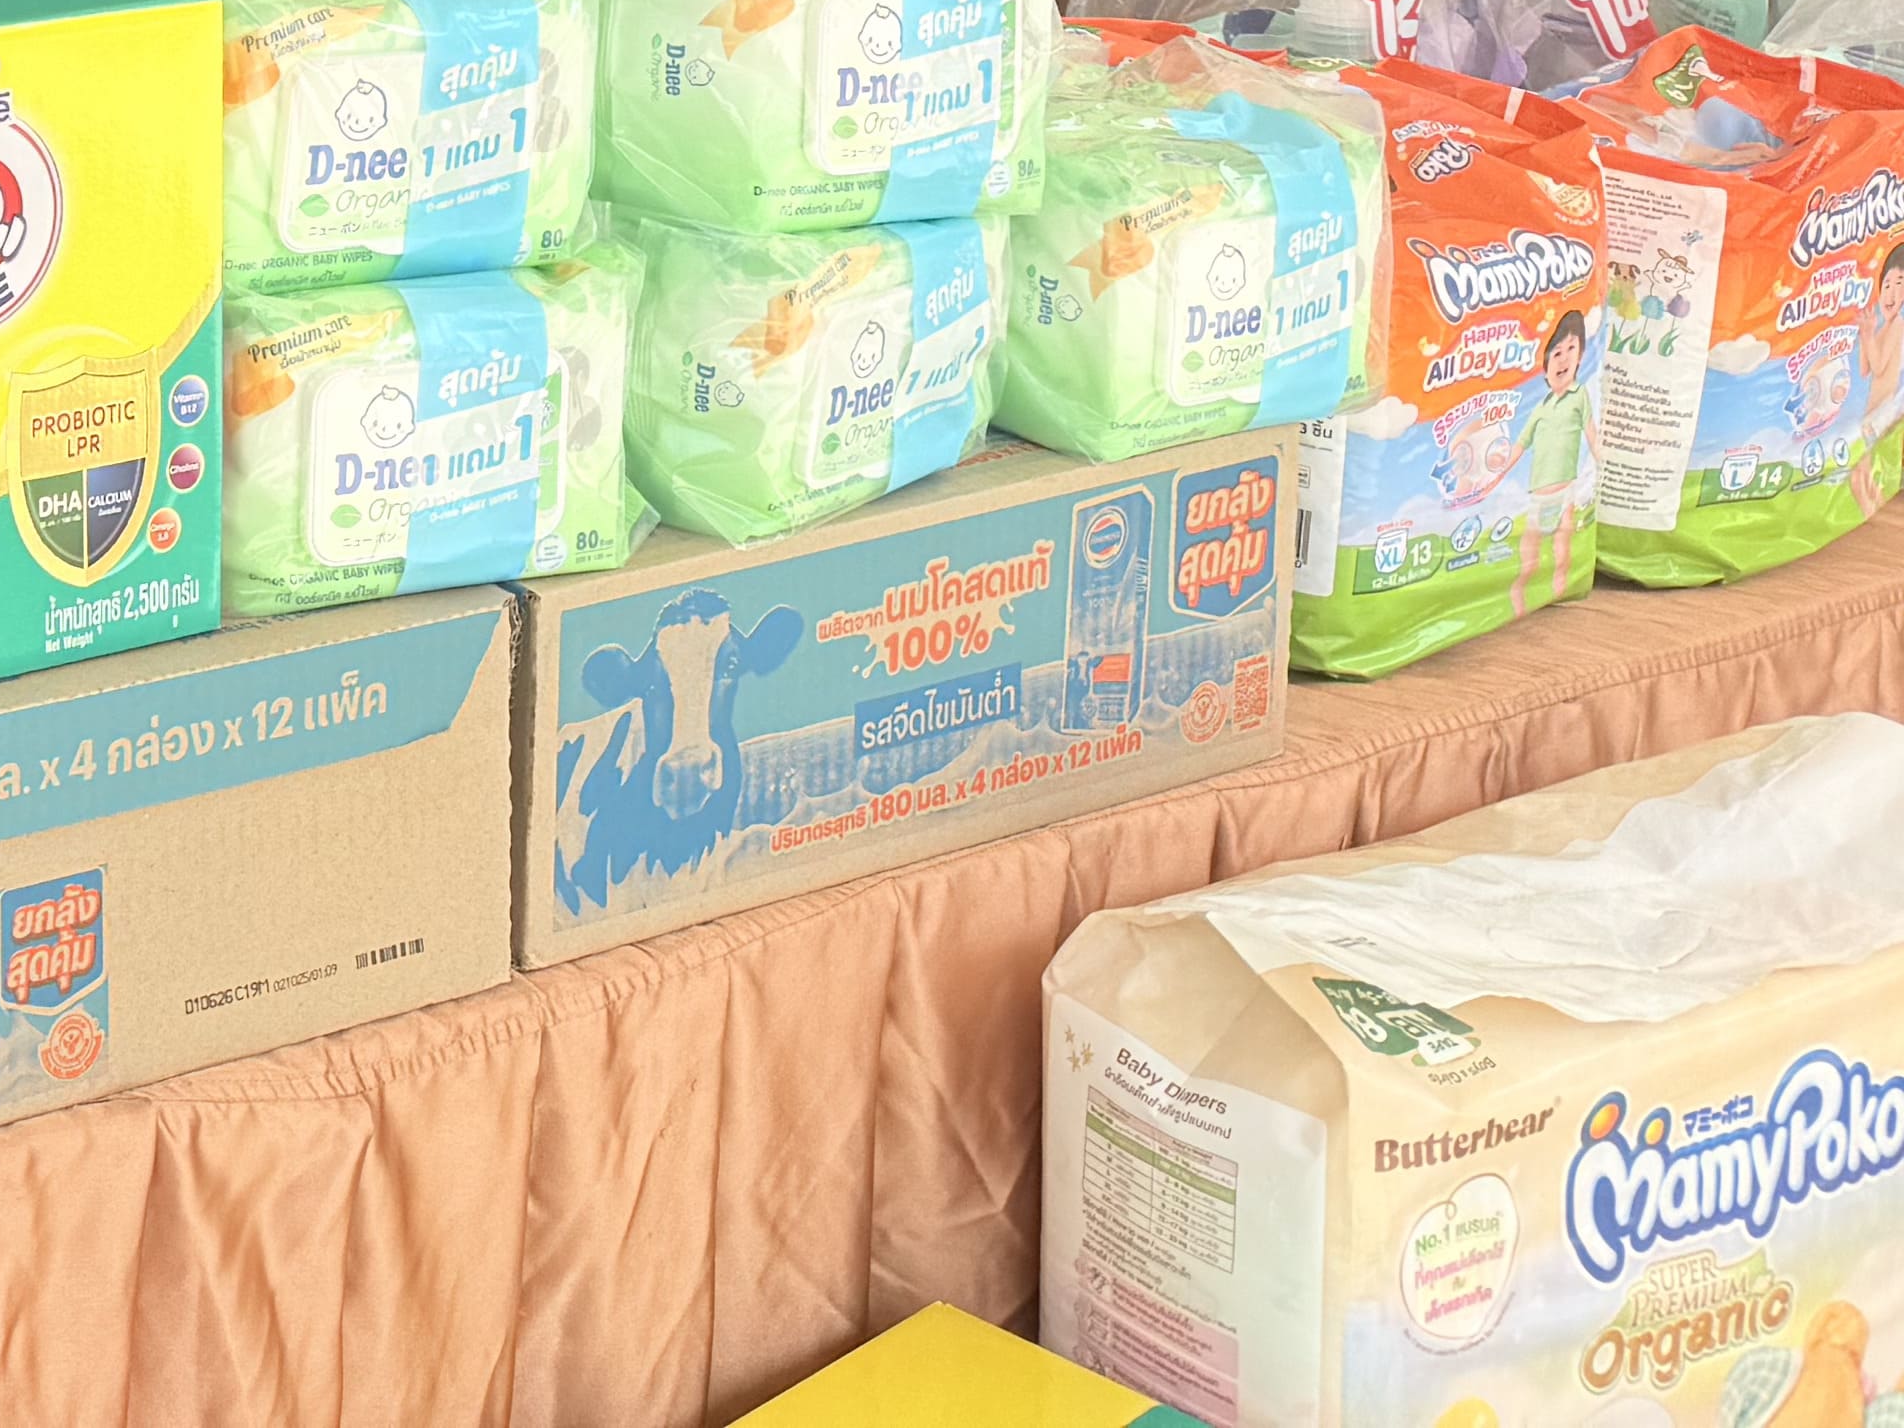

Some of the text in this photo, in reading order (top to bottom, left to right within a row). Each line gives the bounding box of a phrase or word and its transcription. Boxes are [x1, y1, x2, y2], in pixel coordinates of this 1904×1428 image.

[241, 8, 335, 54] Premium care
[439, 42, 518, 101] สุดคุ้ม
[665, 42, 686, 98] D-nee
[904, 59, 994, 124] 1 แถม 1
[304, 144, 408, 187] D-nee
[421, 107, 527, 177] 1 แถม 1
[789, 183, 831, 197] ORGANIC
[261, 249, 374, 270] ORGANIC BABY WIPES
[541, 229, 563, 249] 80
[1287, 210, 1343, 265] สุดคุ้ม
[925, 264, 976, 327] สุดคุ้ม
[1038, 274, 1060, 326] D-nee
[1408, 228, 1594, 326] MamyPoko
[1811, 262, 1856, 291] Happy
[1185, 304, 1262, 344] D-nee
[1274, 269, 1349, 337] 1 แถม 1
[1778, 275, 1874, 331] All Day Dry
[246, 324, 324, 363] Premium
[1463, 320, 1519, 353] Happy
[437, 349, 523, 409] สุดคุ้ม
[693, 362, 717, 414] D-nee
[904, 369, 922, 396] 1
[1424, 340, 1540, 393] All Day Dry
[32, 399, 136, 438] PROBIOTIC
[825, 377, 895, 426] D-nee
[66, 433, 101, 458] LPR
[422, 412, 535, 487] 1 แถม 1
[1311, 418, 1334, 440] ชิ้น
[1184, 469, 1275, 533] ยกลัง
[1730, 464, 1784, 489] L 14
[38, 489, 83, 519] DHA
[575, 529, 599, 551] 80
[1177, 518, 1269, 608] สุดคุ้ม
[1379, 539, 1433, 571] XL 13
[289, 560, 405, 587] ORGANIC BABY WIPES
[816, 540, 1055, 642] ผลิตจาก นมโคสดแท้
[44, 573, 201, 636] น้ำหนักสุทธิ 2,500 กรัม
[45, 630, 95, 654] Net Weight
[882, 611, 991, 675] 100%
[39, 756, 61, 789] x
[67, 737, 98, 783] 4
[104, 713, 217, 779] กล่อง
[222, 716, 245, 752] x
[250, 694, 295, 744] 12
[302, 666, 389, 733] แพ็ค
[860, 669, 1017, 747] รสจืดไขมันต่ำ
[770, 722, 1144, 853] ปริมาตรสุทธิ 180 มล. x 4 กล่อง x 12 แพ็ค
[10, 882, 103, 942] ยกลัง
[4, 930, 95, 1006] สุดคุ้ม
[1427, 1036, 1461, 1055] TAPE
[1427, 1056, 1497, 1086] Boys Girls
[1115, 1045, 1229, 1117] Baby Diapers
[1373, 1102, 1555, 1174] Butterbear
[1681, 1093, 1755, 1138] マミーポコ
[1414, 1208, 1501, 1257] No.1 แบรนด์
[1648, 1256, 1718, 1292] SUPER
[1629, 1279, 1751, 1326] PREMIUM
[1580, 1281, 1795, 1389] Organic
